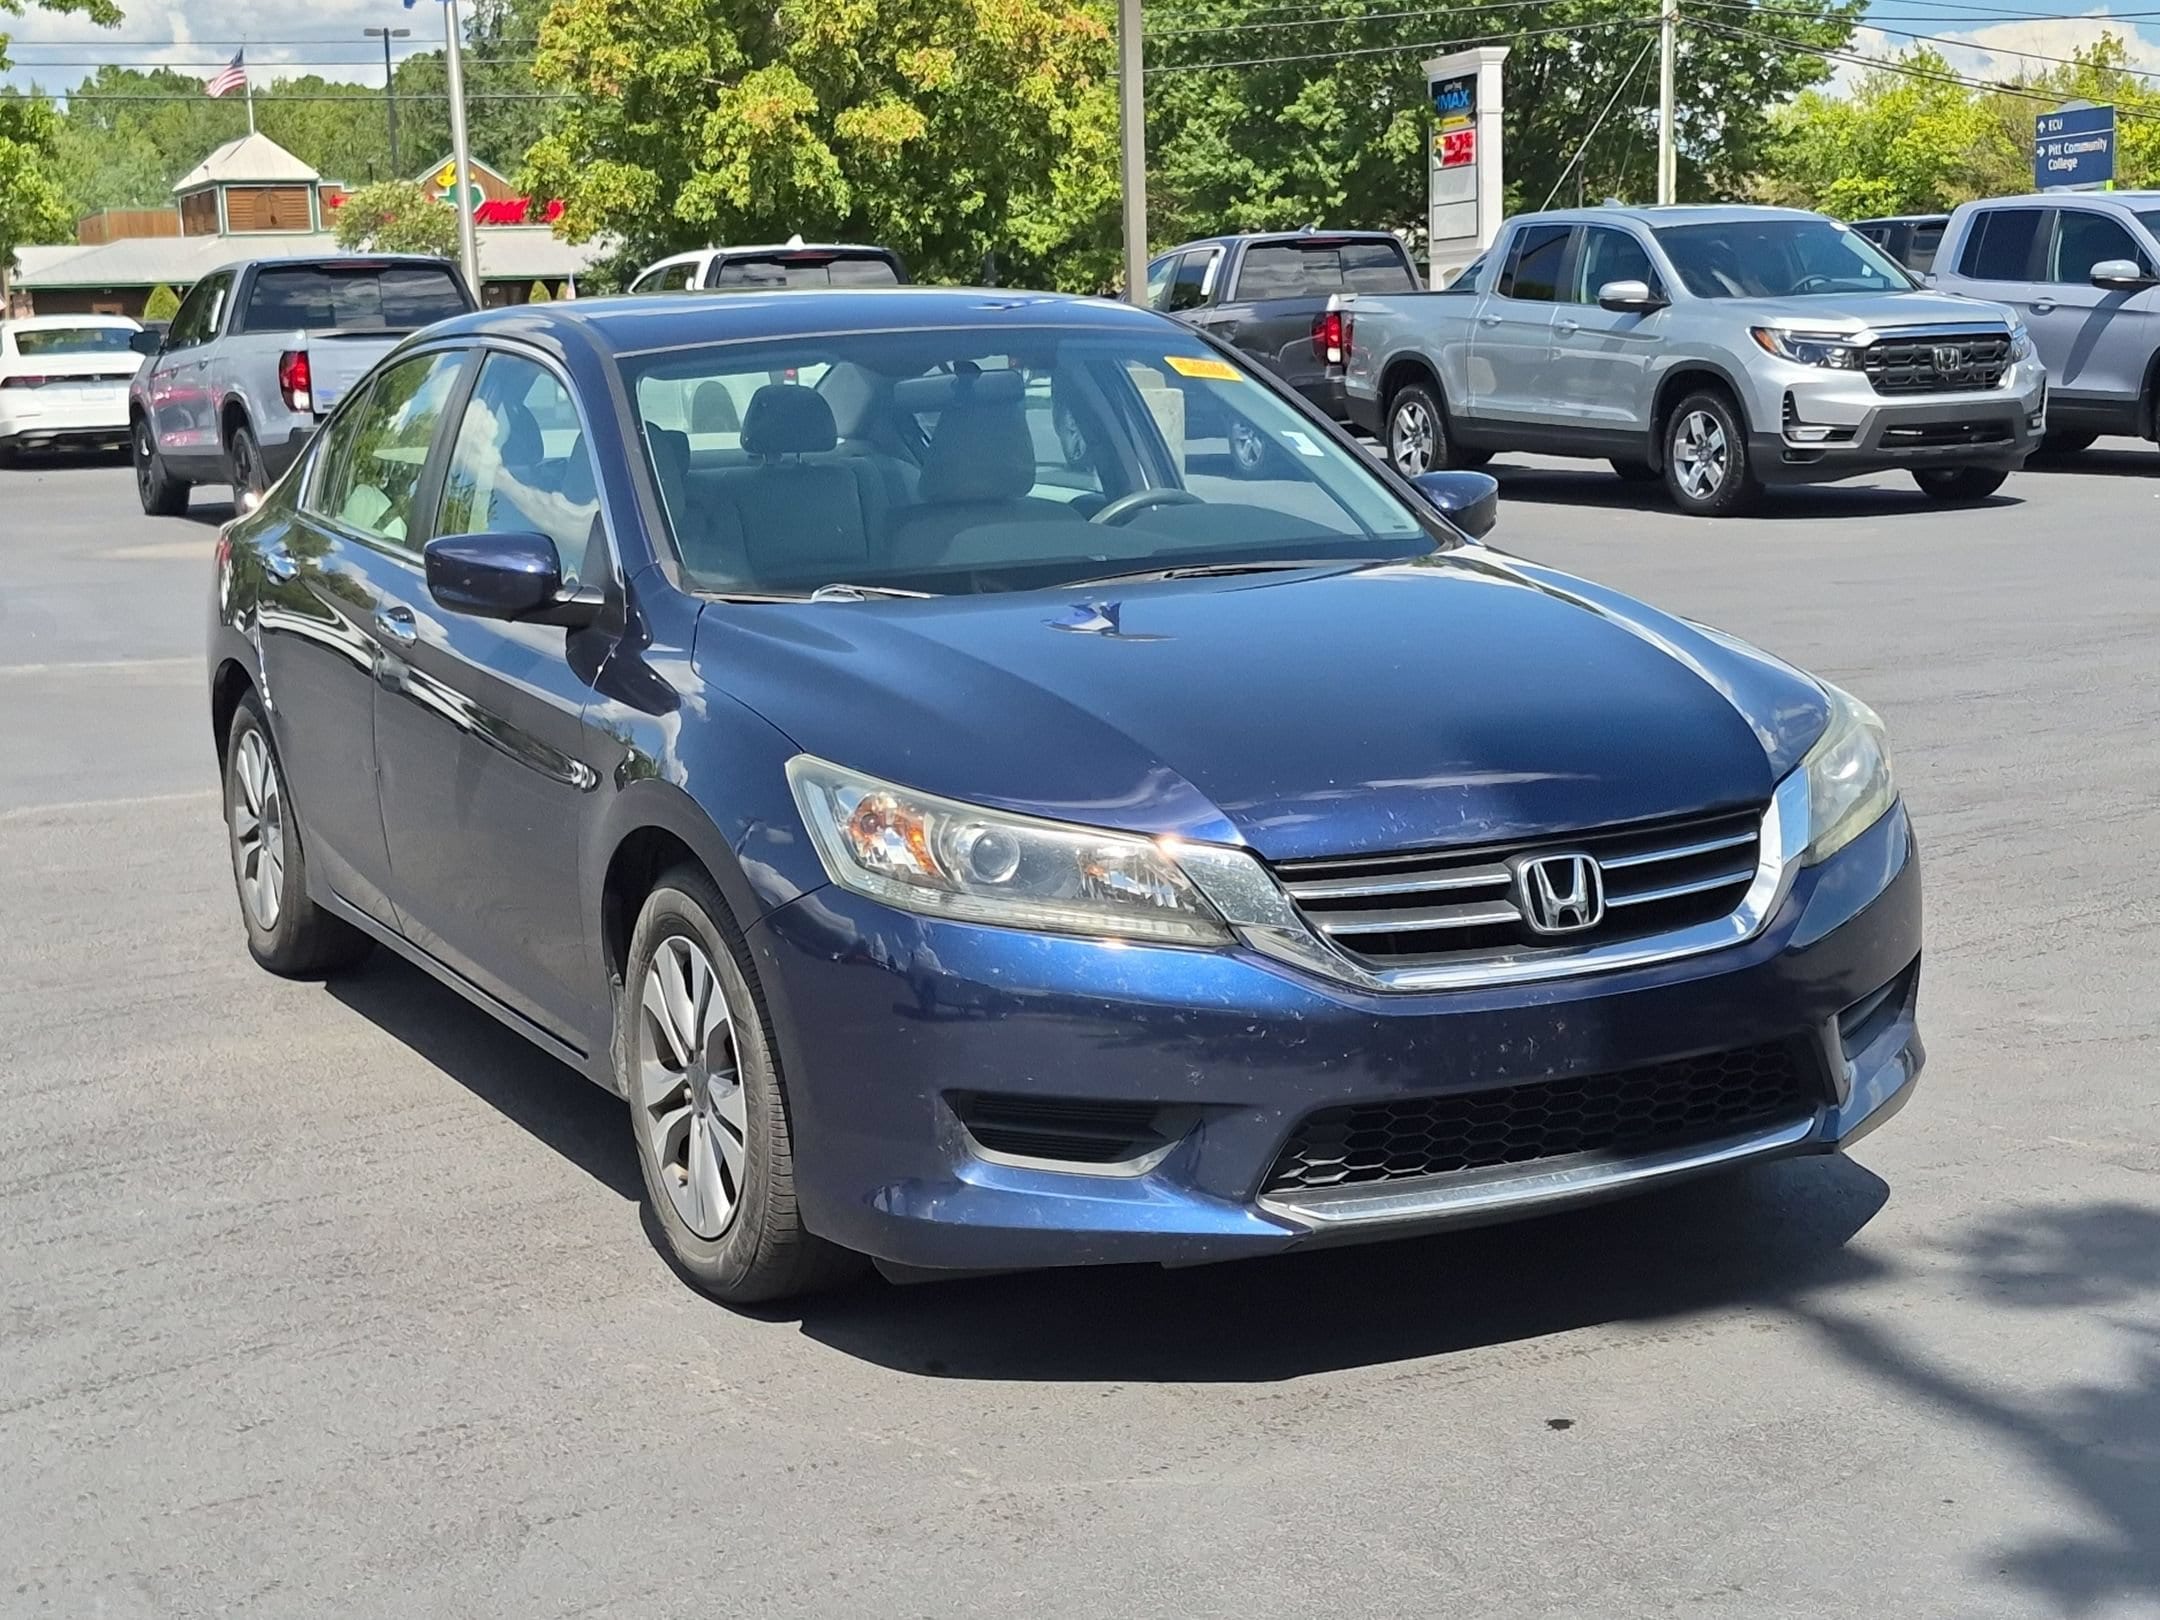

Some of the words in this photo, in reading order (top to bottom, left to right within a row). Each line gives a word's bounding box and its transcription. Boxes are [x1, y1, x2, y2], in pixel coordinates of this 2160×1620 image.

[2048, 118, 2063, 131] ECU
[2063, 137, 2107, 154] Community
[2048, 157, 2078, 171] College
